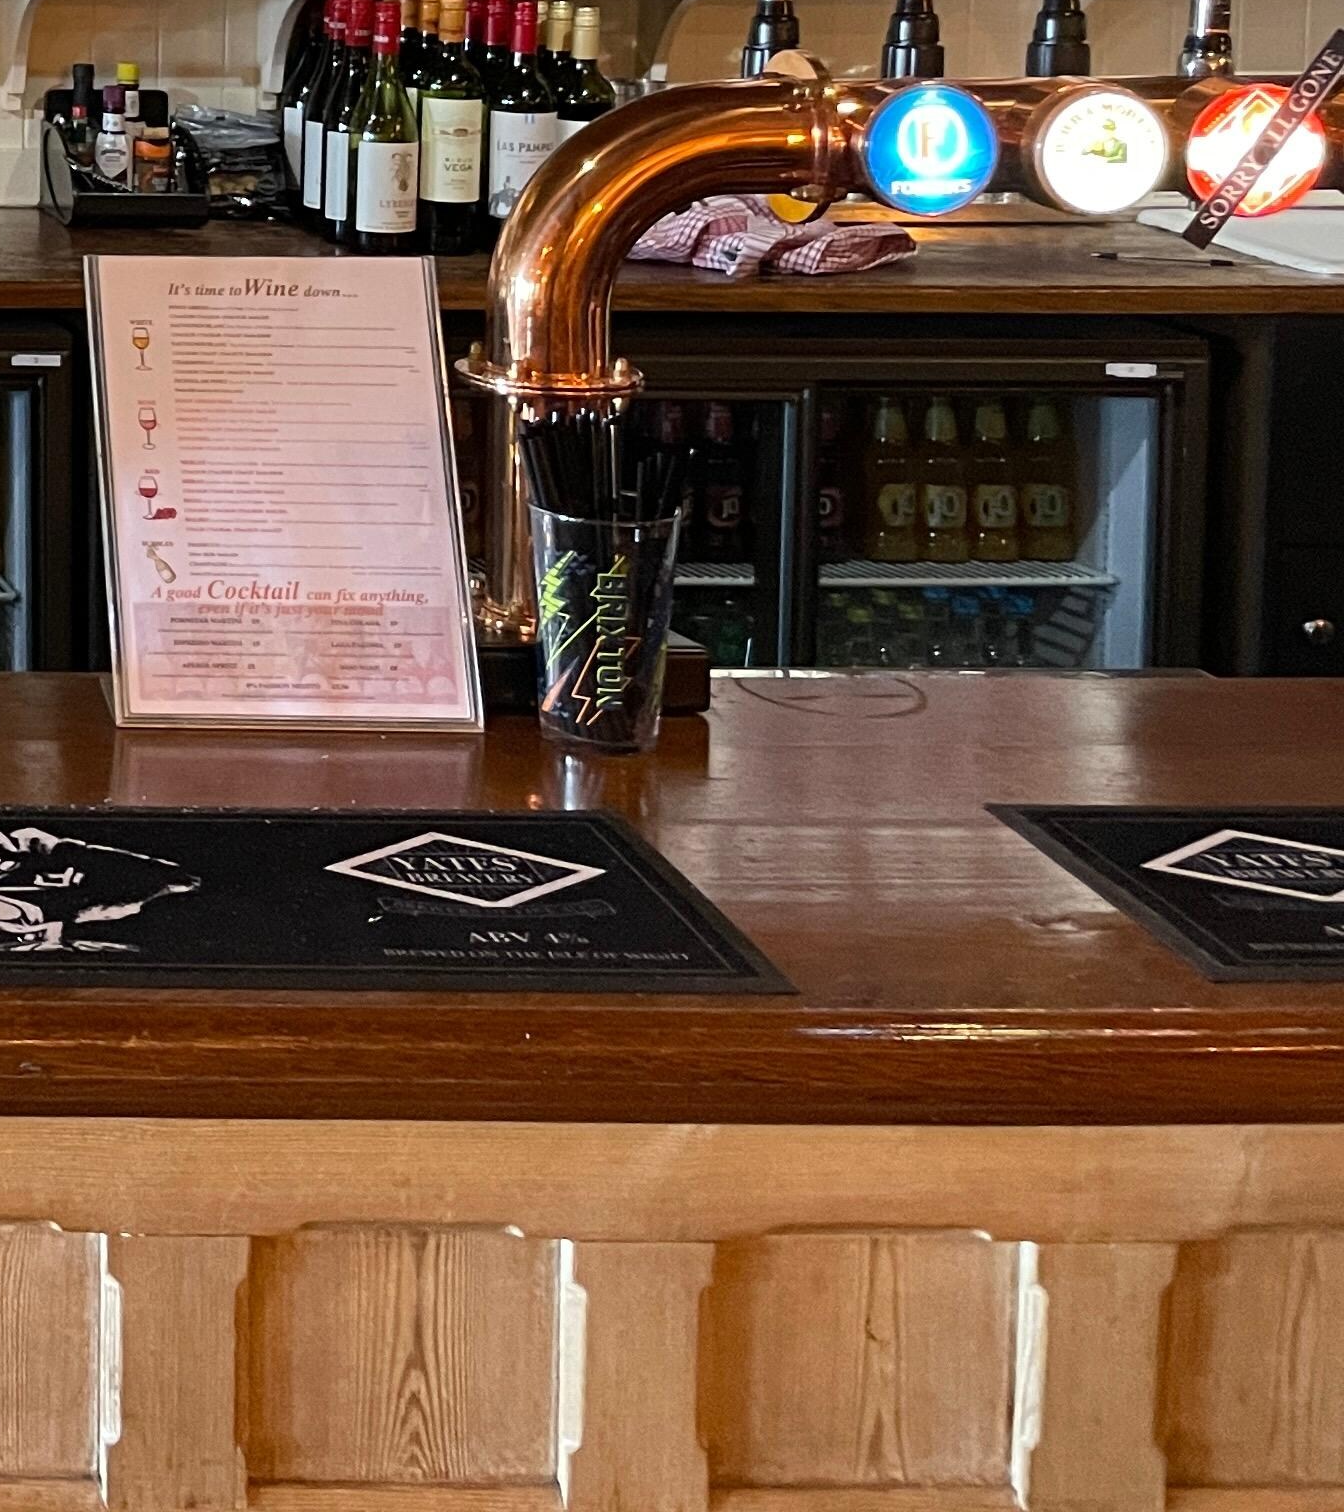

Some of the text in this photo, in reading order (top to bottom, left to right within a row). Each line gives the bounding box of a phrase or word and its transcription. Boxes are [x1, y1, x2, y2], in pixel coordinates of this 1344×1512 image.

[1200, 148, 1265, 230] SORRY
[1289, 48, 1343, 112] GONE
[168, 283, 191, 296] It's
[195, 284, 225, 296] time
[229, 285, 242, 296] to
[244, 278, 299, 297] Wine
[151, 580, 430, 606] A good Cocktail can fix anything,
[406, 873, 536, 884] BREWERY
